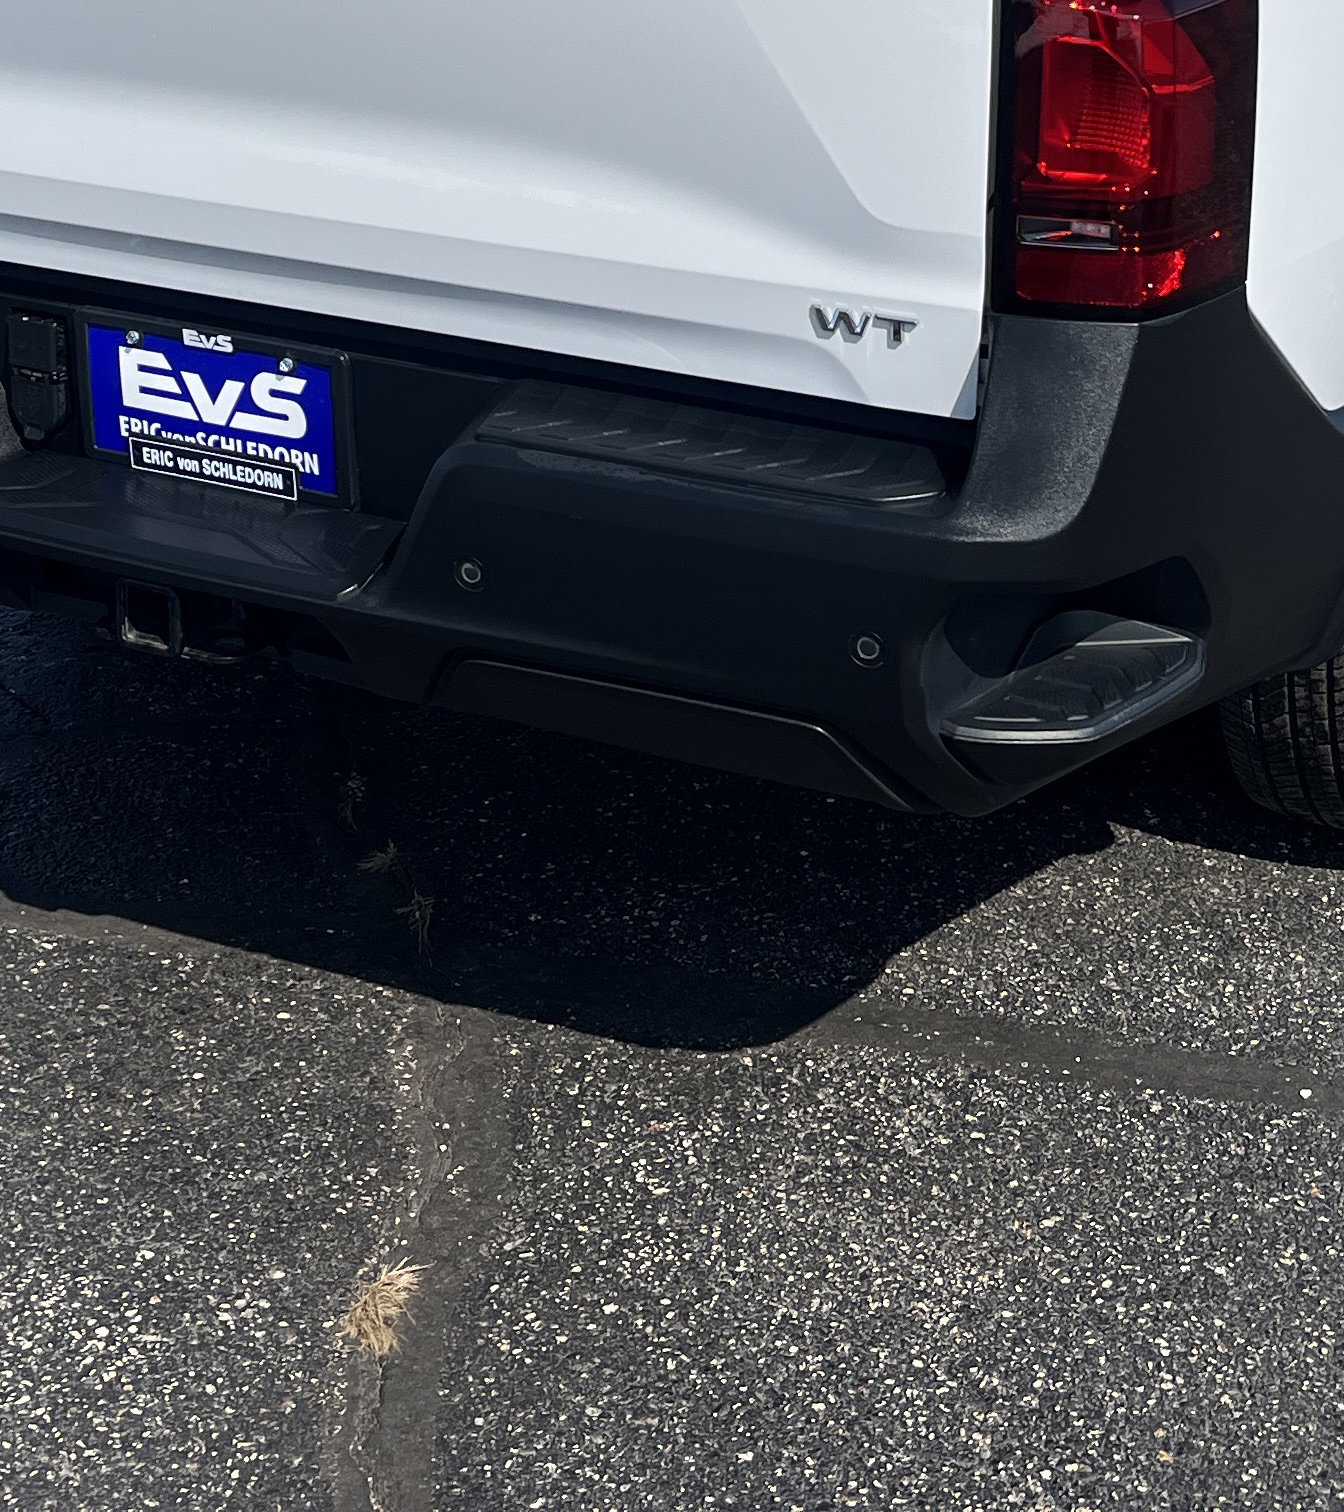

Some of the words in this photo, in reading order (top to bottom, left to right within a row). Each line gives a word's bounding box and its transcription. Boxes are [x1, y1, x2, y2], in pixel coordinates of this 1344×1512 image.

[809, 303, 918, 346] WT
[142, 447, 174, 468] ERIC
[176, 456, 200, 474] von
[202, 459, 284, 490] SCHLEDORN
